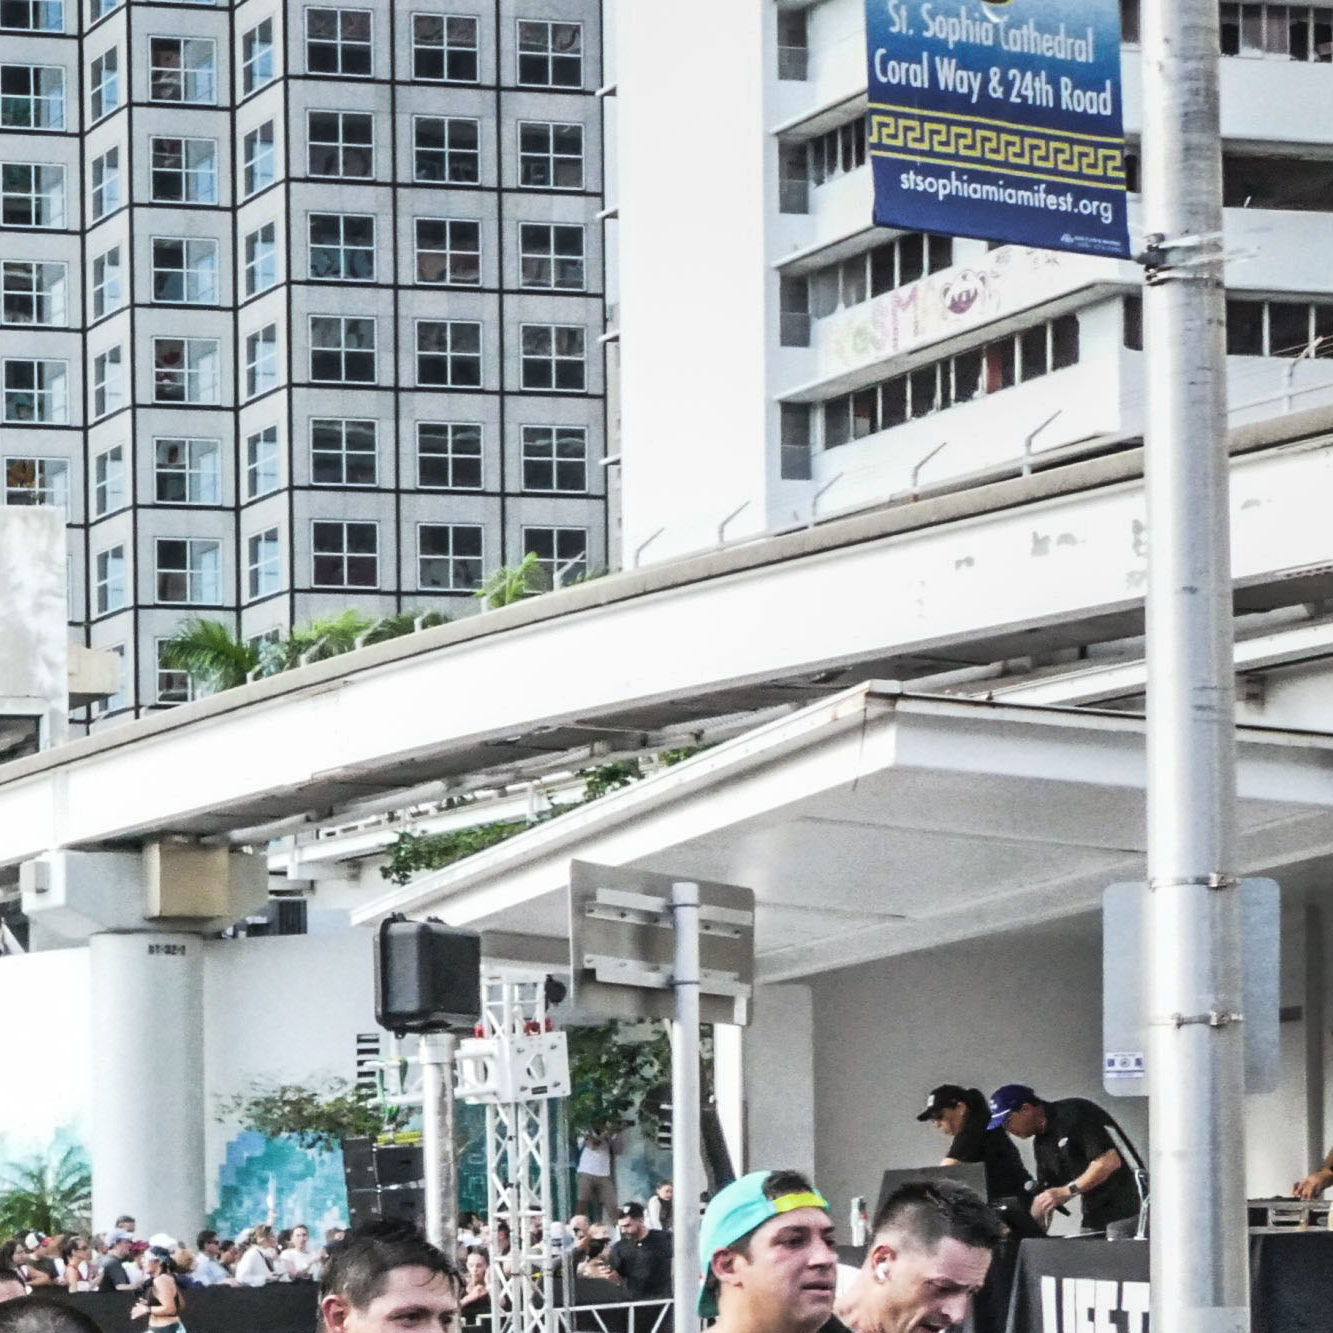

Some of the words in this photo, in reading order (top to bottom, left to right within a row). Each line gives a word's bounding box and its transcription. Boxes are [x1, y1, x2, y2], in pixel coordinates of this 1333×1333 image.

[888, 0, 914, 35] St.
[921, 3, 994, 49] Sophia
[1000, 17, 1095, 64] Cathedral
[874, 47, 929, 89] Coral
[935, 56, 982, 104] Way
[988, 66, 1004, 99] &
[1008, 69, 1054, 108] 24th
[1060, 77, 1112, 116] Road
[900, 170, 1113, 224] stsophiamiamifest.org
